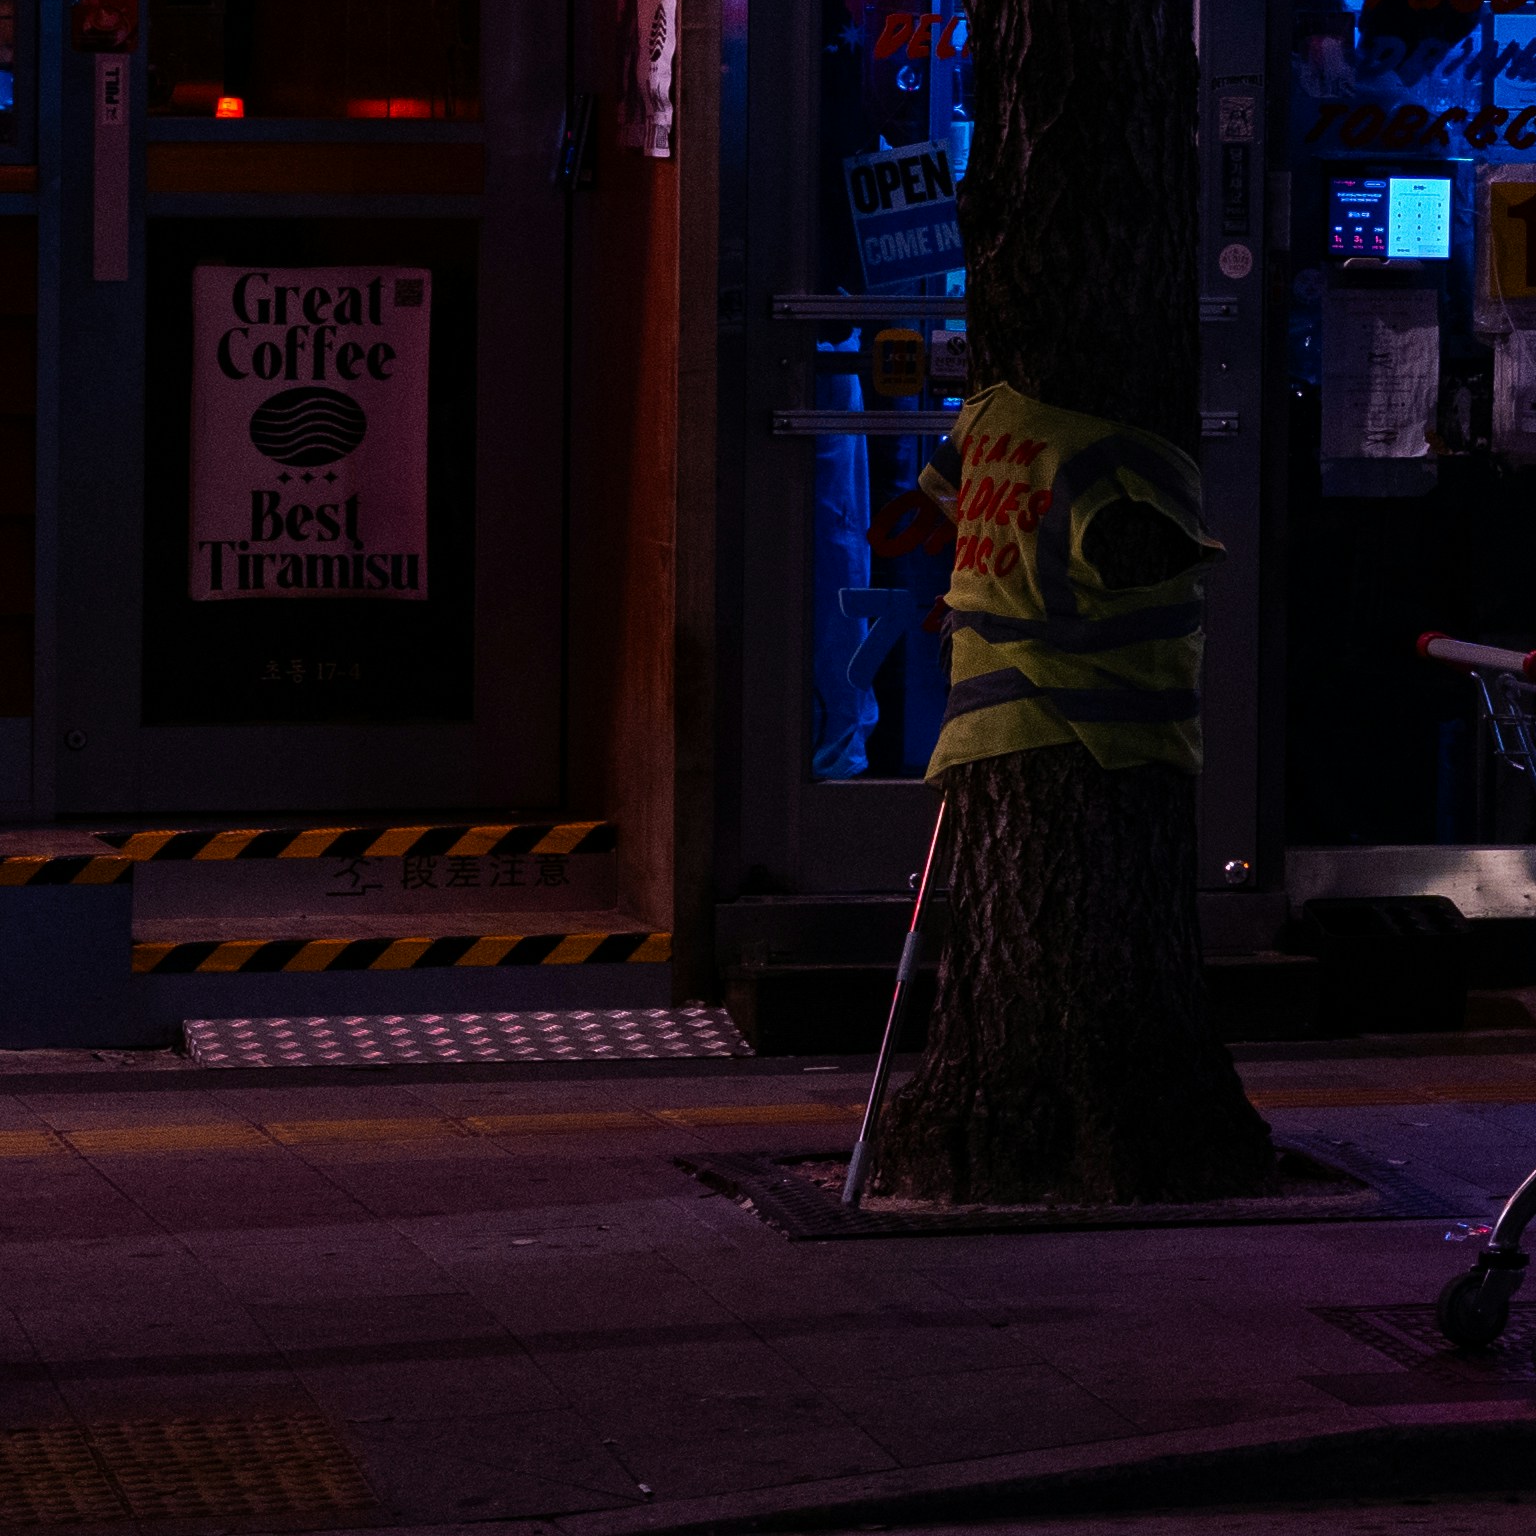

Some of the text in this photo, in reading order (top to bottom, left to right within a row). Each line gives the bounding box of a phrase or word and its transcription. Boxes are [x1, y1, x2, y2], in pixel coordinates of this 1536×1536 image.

[873, 12, 969, 60] DEL
[105, 67, 120, 105] PULL
[850, 153, 953, 215] OPEN
[864, 220, 961, 266] COME IN
[232, 272, 384, 325] Great
[217, 325, 397, 381] Coffee
[250, 489, 364, 549] Best
[200, 540, 420, 593] Tiramisu
[315, 661, 362, 683] 17-4
[400, 852, 571, 891] 段差注意
